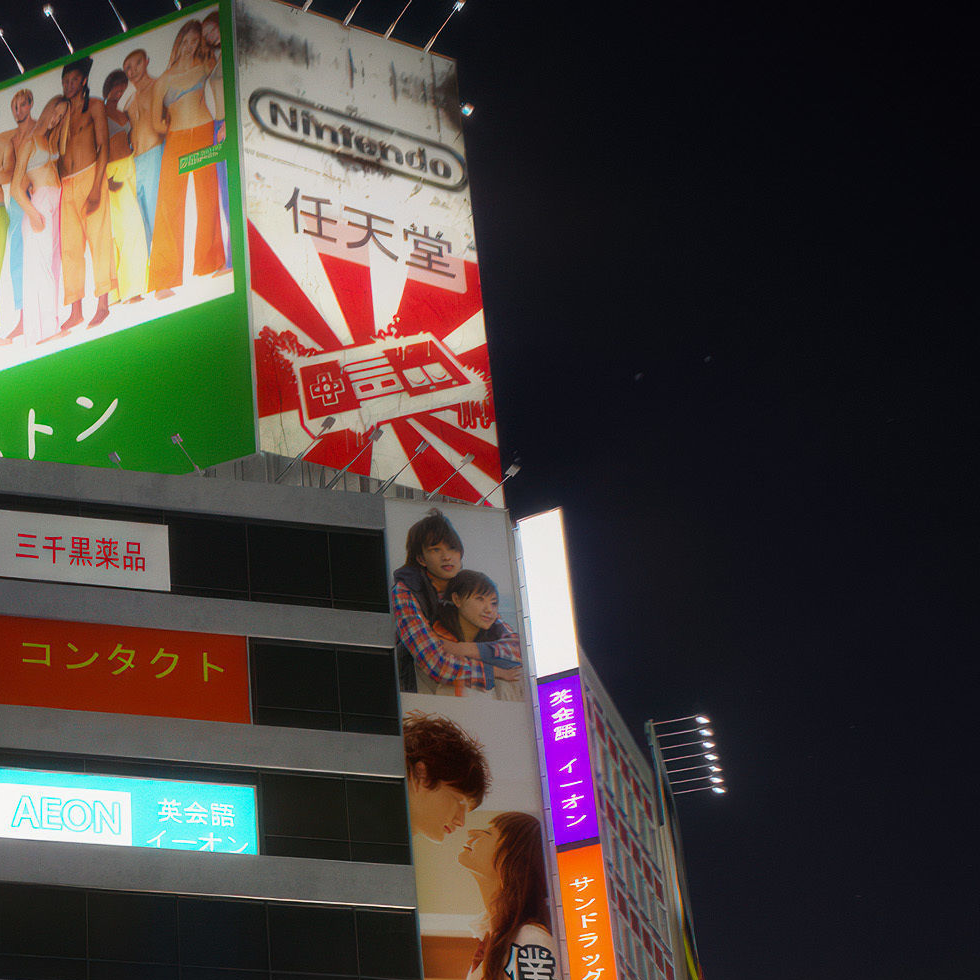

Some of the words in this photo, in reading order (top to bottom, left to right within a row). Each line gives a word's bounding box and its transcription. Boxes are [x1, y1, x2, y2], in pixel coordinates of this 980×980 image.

[270, 100, 452, 179] Nintendo
[284, 187, 457, 279] 任天堂
[15, 533, 147, 572] 三千黒薬品
[22, 642, 225, 683] コンタクト
[10, 795, 122, 836] AEON
[157, 798, 236, 828] 英会語
